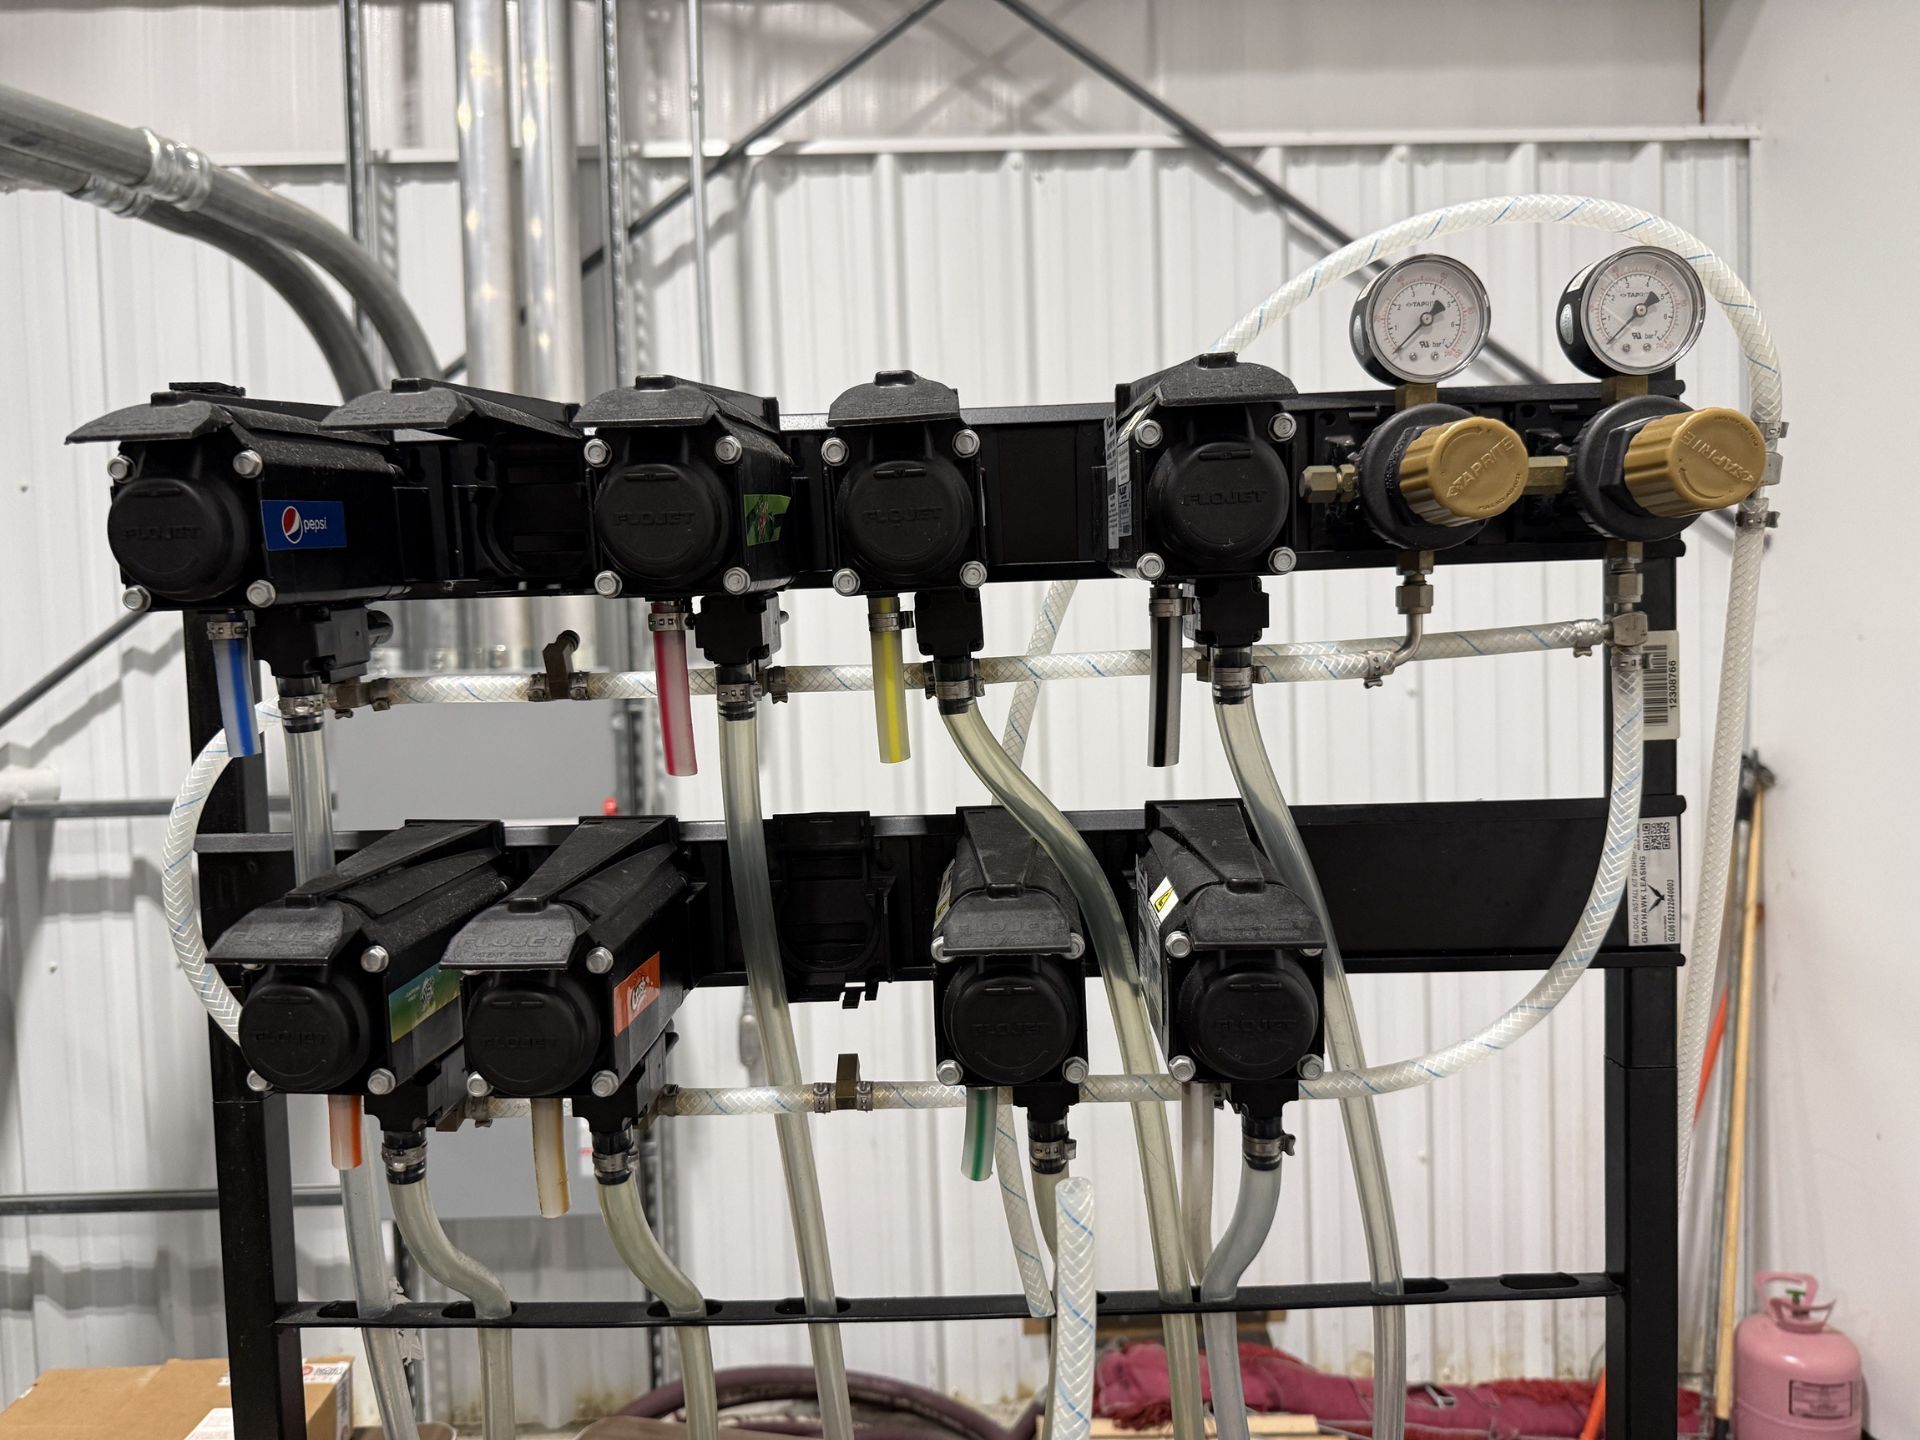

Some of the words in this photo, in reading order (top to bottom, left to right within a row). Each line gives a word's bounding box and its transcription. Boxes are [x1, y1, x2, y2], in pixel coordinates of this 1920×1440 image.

[1453, 435, 1515, 488] TAPRITE
[303, 516, 327, 533] pepsi
[614, 511, 697, 527] FLOJET
[1668, 659, 1677, 709] 12308766
[1639, 855, 1647, 892] LEASING
[1631, 889, 1639, 912] INSTALL
[1631, 914, 1639, 933] LOCAL
[1640, 894, 1648, 944] GRAYHAWK
[461, 934, 570, 948] FLOJET
